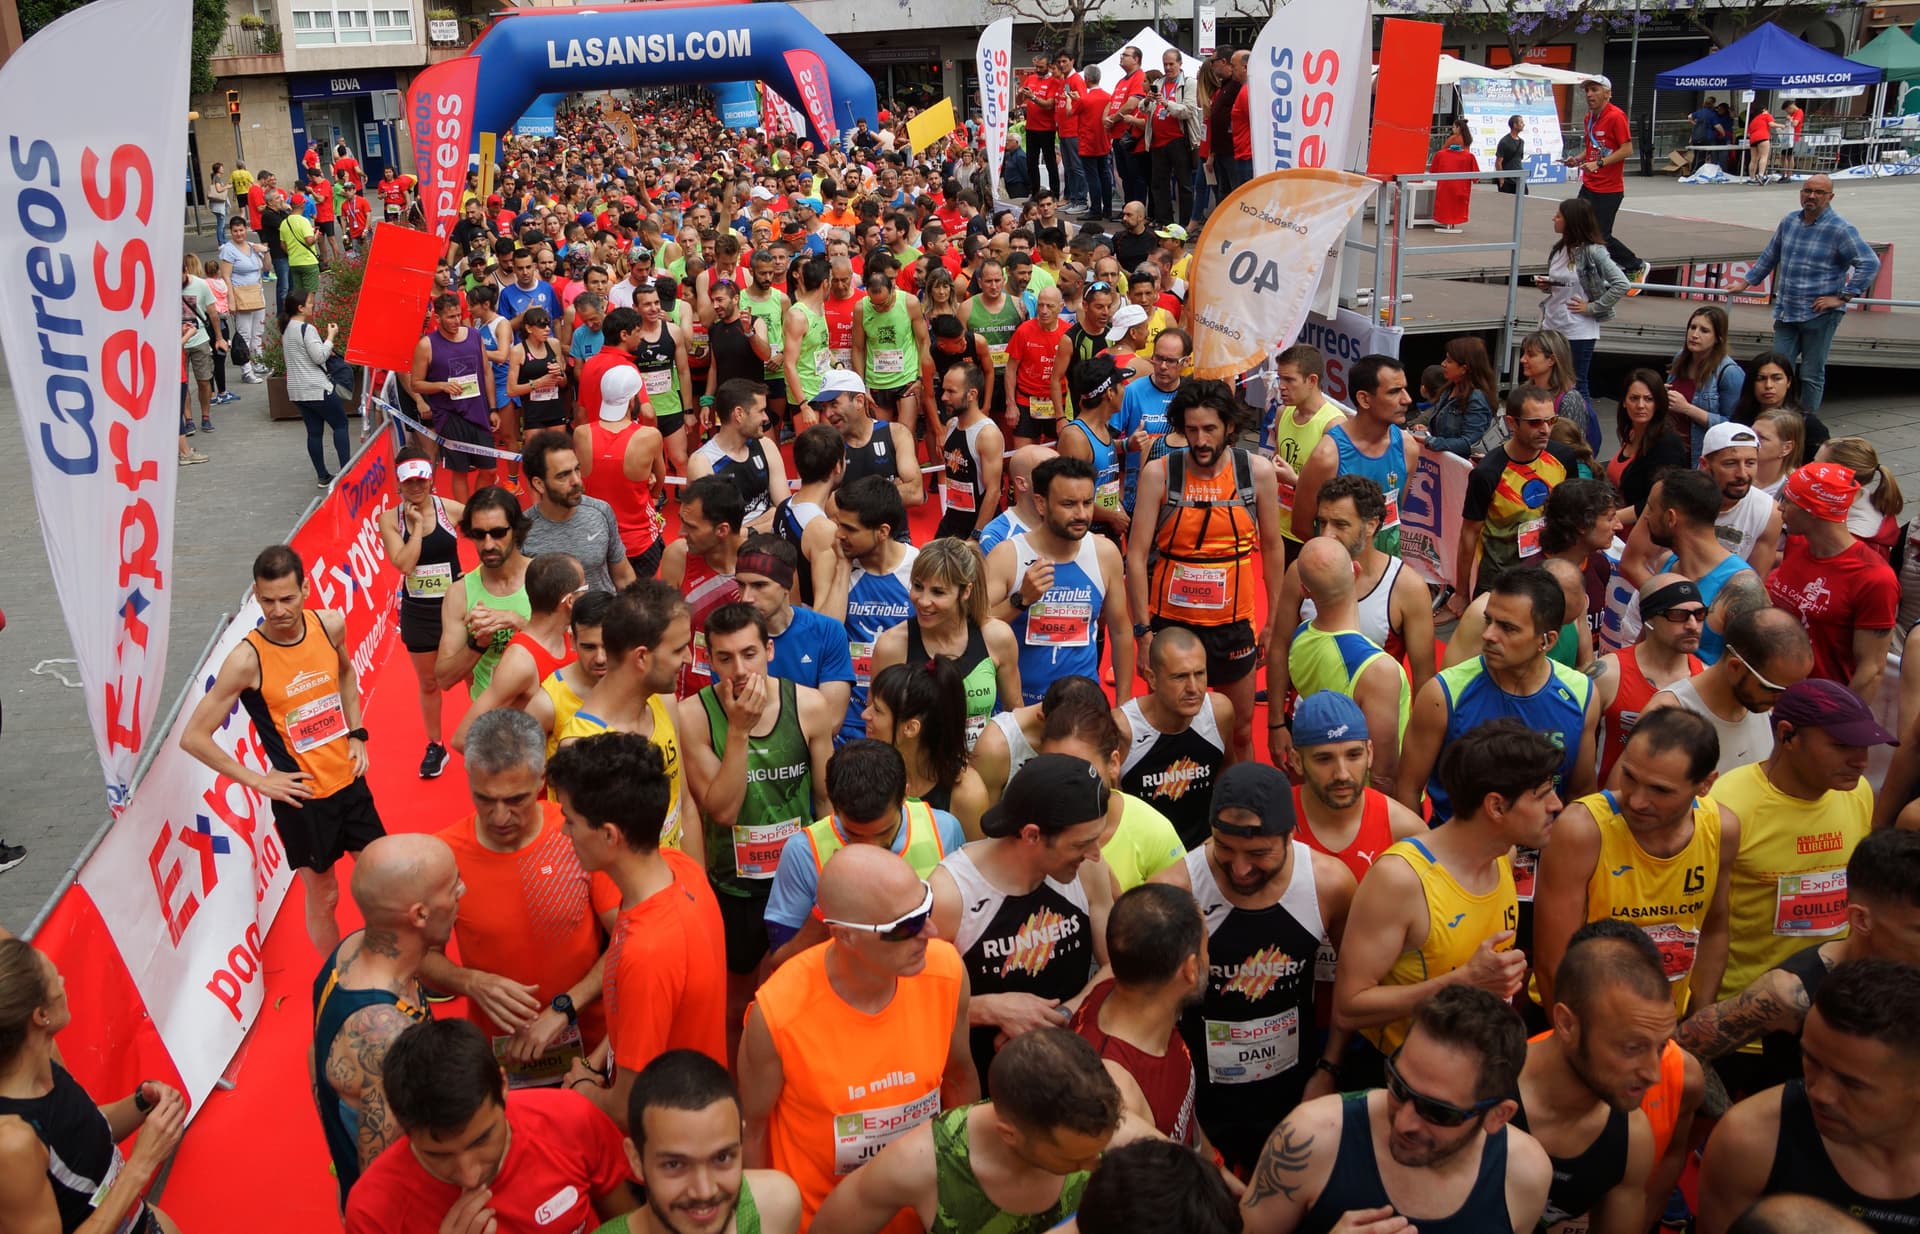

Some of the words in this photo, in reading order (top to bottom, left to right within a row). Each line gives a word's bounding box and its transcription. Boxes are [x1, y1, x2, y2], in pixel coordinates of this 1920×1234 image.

[548, 28, 751, 68] LASANSI.COM
[331, 78, 360, 91] BBVA
[984, 48, 996, 127] Correos
[1676, 78, 1727, 87] LASANSI.COM
[1782, 72, 1851, 86] LASANSI.COM
[10, 135, 98, 476] Correos
[82, 144, 163, 755] Express
[342, 456, 387, 519] Correos
[417, 578, 441, 589] 764
[1182, 586, 1212, 595] QUICO
[1040, 624, 1066, 632] JOSE
[1142, 764, 1210, 788] RUNNERS
[750, 827, 800, 842] Express
[1684, 866, 1704, 892] LS
[1801, 878, 1846, 892] Expre
[1612, 901, 1704, 918] LASANSI.COM
[983, 914, 1080, 958] RUNNERS
[1210, 959, 1306, 979] RUNNERS
[1230, 1016, 1296, 1039] Express
[1239, 1046, 1276, 1062] DANI
[848, 1086, 866, 1100] la
[870, 1070, 916, 1092] milla
[864, 1102, 938, 1130] Express
